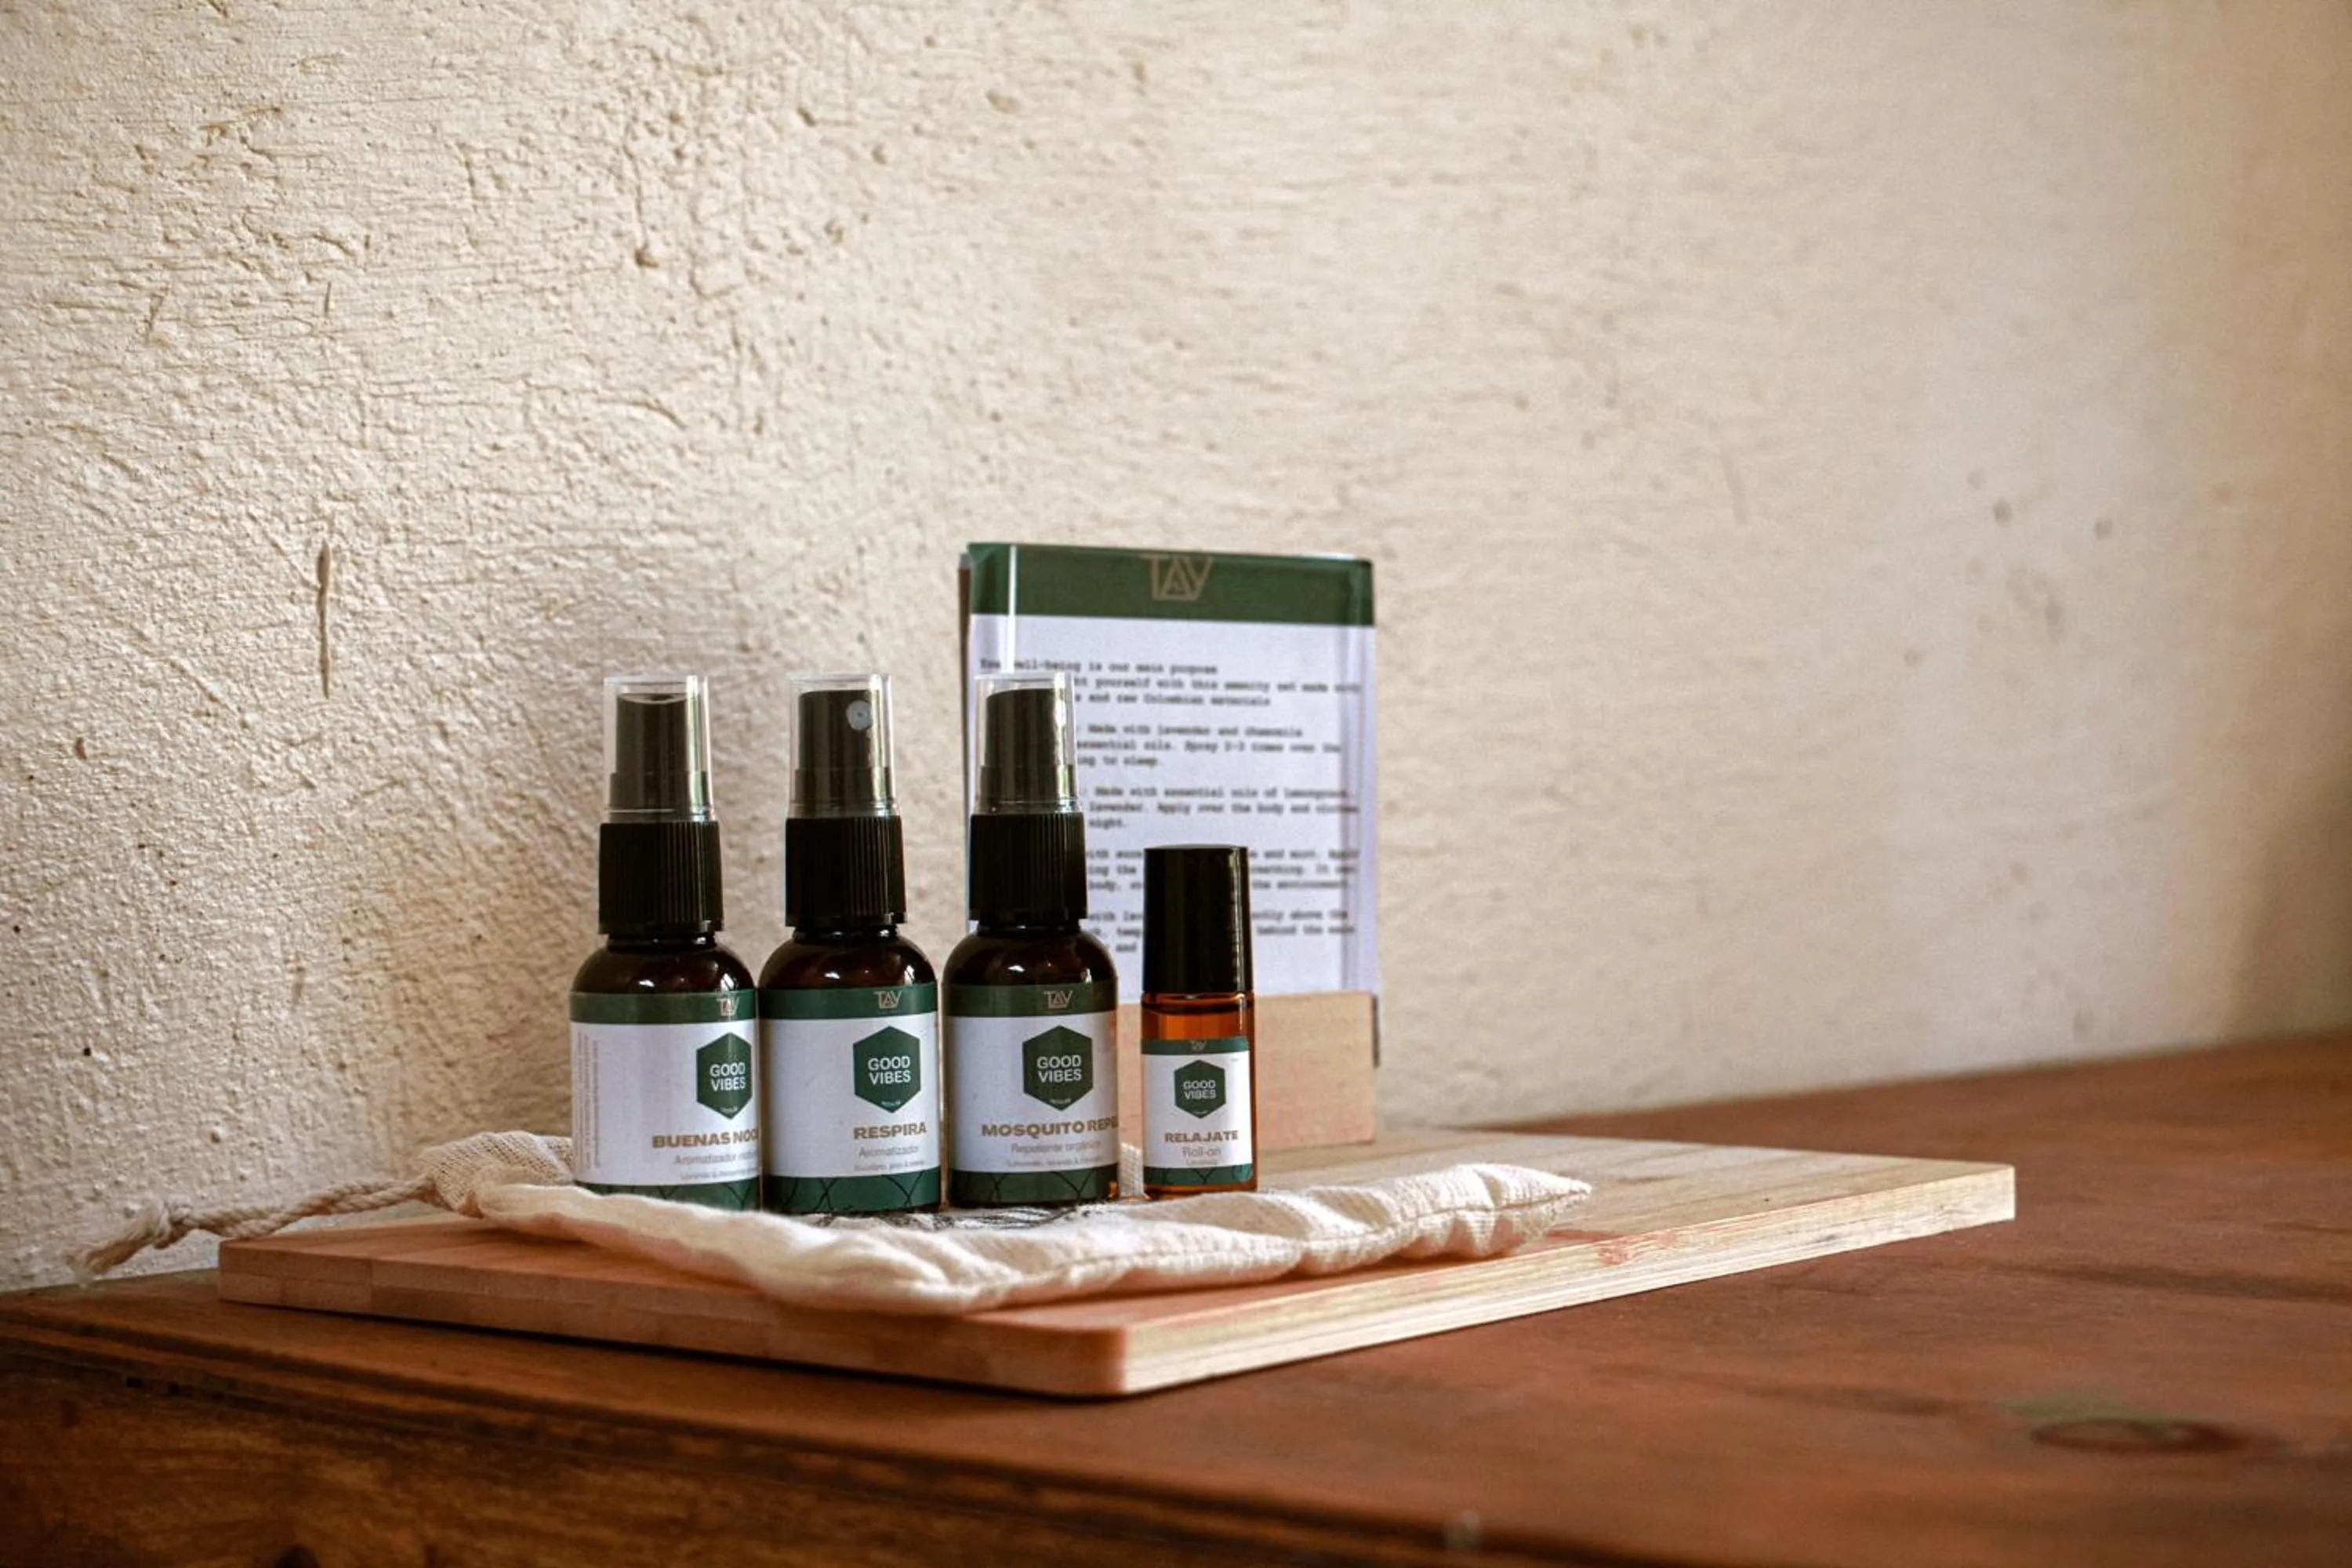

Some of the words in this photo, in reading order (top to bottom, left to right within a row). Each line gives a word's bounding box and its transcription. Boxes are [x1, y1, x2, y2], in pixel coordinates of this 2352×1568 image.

[1089, 662, 1102, 673] is
[1109, 663, 1129, 673] our
[1136, 662, 1163, 673] main
[1170, 664, 1218, 676] purpose
[1096, 677, 1150, 690] yourself
[1156, 677, 1184, 690] with
[1191, 678, 1218, 690] this
[1302, 681, 1329, 692] made
[1088, 691, 1109, 703] and
[1143, 691, 1203, 705] Colombian
[1210, 694, 1271, 706] materials
[1087, 724, 1116, 735] Made
[1123, 724, 1150, 735] with
[1156, 724, 1210, 736] lavender
[1218, 725, 1239, 737] and
[1185, 739, 1218, 753] Spray
[1250, 742, 1283, 753] times
[1290, 743, 1316, 753] over
[1323, 742, 1341, 753] the
[1102, 756, 1118, 766] to
[1094, 786, 1123, 797] Made
[1129, 786, 1157, 797] with
[1163, 787, 1225, 798] essential
[1230, 787, 1258, 798] oils
[1264, 786, 1279, 797] of
[1156, 802, 1191, 816] Apply
[1197, 804, 1225, 814] over
[1230, 803, 1252, 814] the
[1256, 802, 1283, 816] body
[1290, 803, 1311, 814] and
[867, 1056, 911, 1071] GOOD
[1036, 1054, 1082, 1069] GOOD
[710, 1062, 746, 1077] GOOD
[1038, 1069, 1083, 1083] VIBES
[711, 1076, 746, 1092] VIBES
[868, 1070, 911, 1085] VIBES
[1183, 1080, 1216, 1090] GOOD
[1185, 1089, 1217, 1100] VIBES
[853, 1122, 927, 1140] RESPIRA
[982, 1120, 1085, 1139] MOSQUITO
[1164, 1130, 1239, 1142] RELAJATE
[652, 1131, 731, 1149] BUENAS
